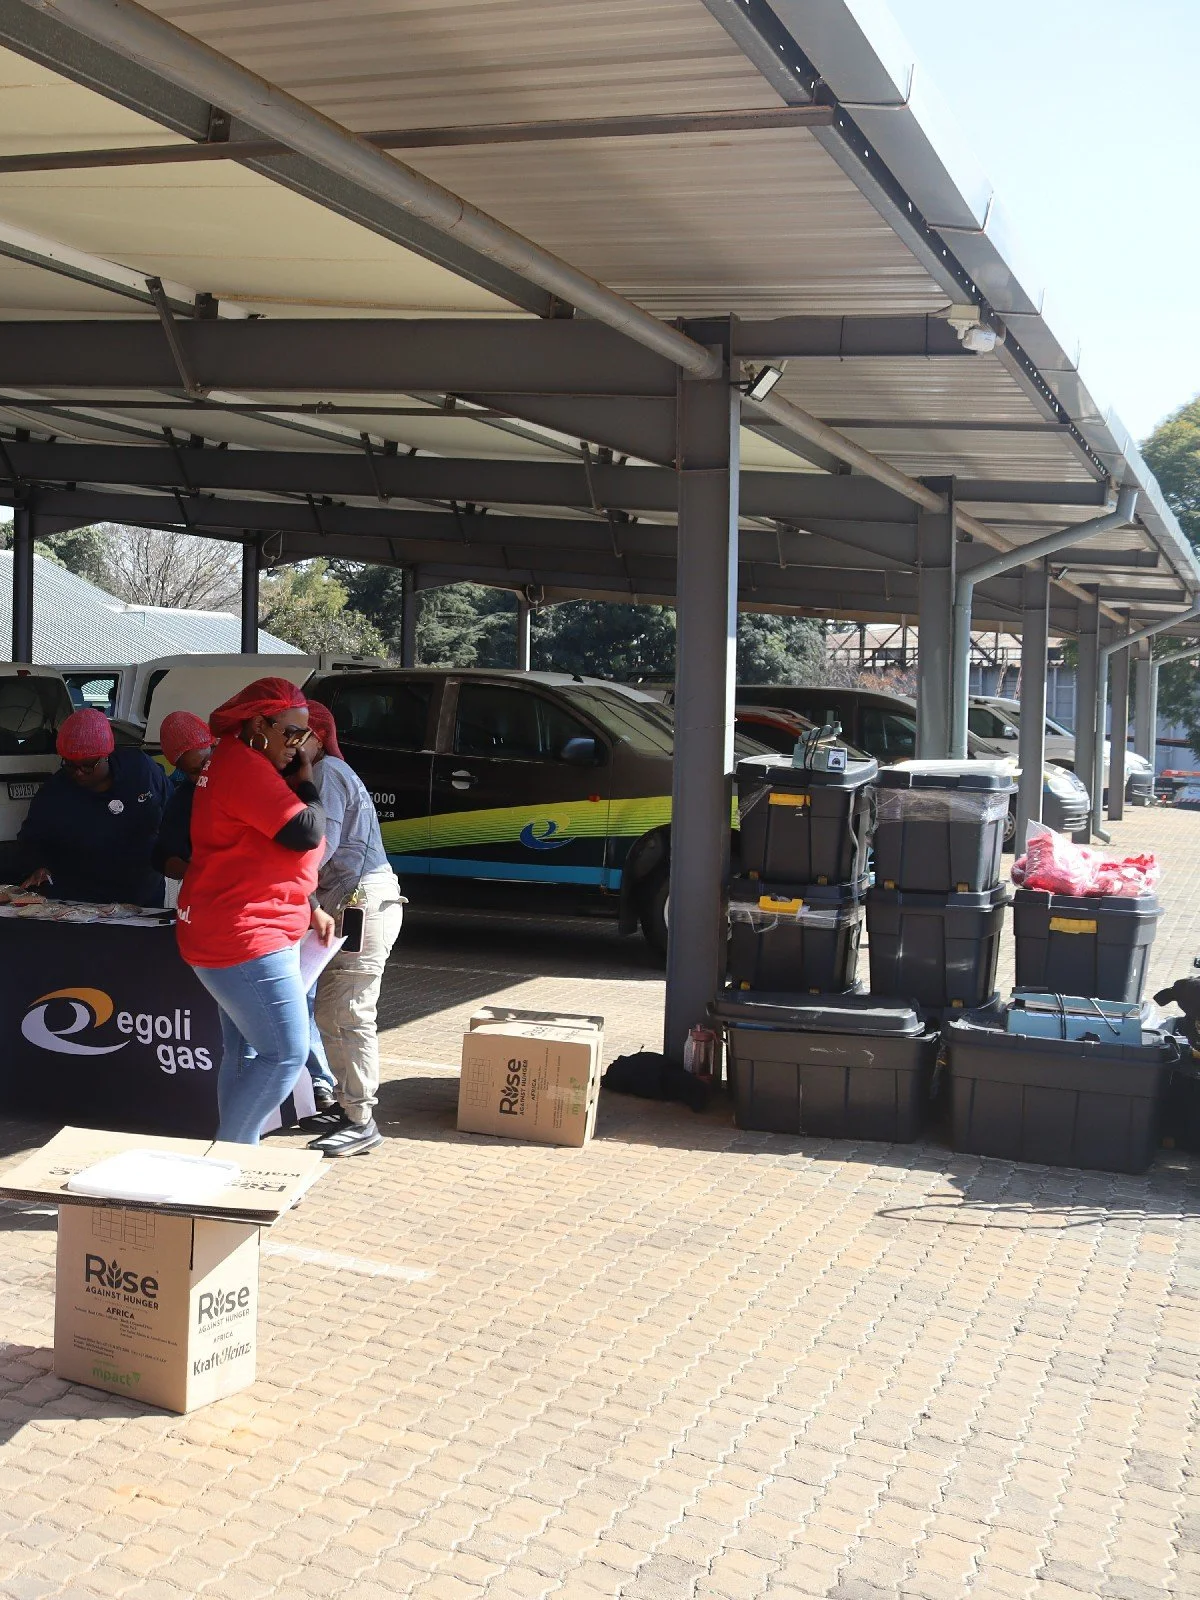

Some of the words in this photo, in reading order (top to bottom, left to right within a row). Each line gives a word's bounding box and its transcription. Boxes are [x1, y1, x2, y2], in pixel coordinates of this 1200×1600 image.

[377, 810, 395, 818] o.za
[116, 1008, 192, 1044] egoli
[156, 1042, 213, 1075] gas
[85, 1253, 159, 1299] Rise
[85, 1286, 121, 1300] AGAINST
[123, 1294, 159, 1310] HUNGER
[197, 1286, 250, 1325] Rise
[106, 1306, 135, 1319] AFRICA
[198, 1318, 224, 1335] AGAINST
[225, 1308, 250, 1324] HUNGER
[213, 1331, 234, 1344] AFRICA
[193, 1342, 252, 1376] KraftHeinz
[91, 1366, 132, 1388] mpact
